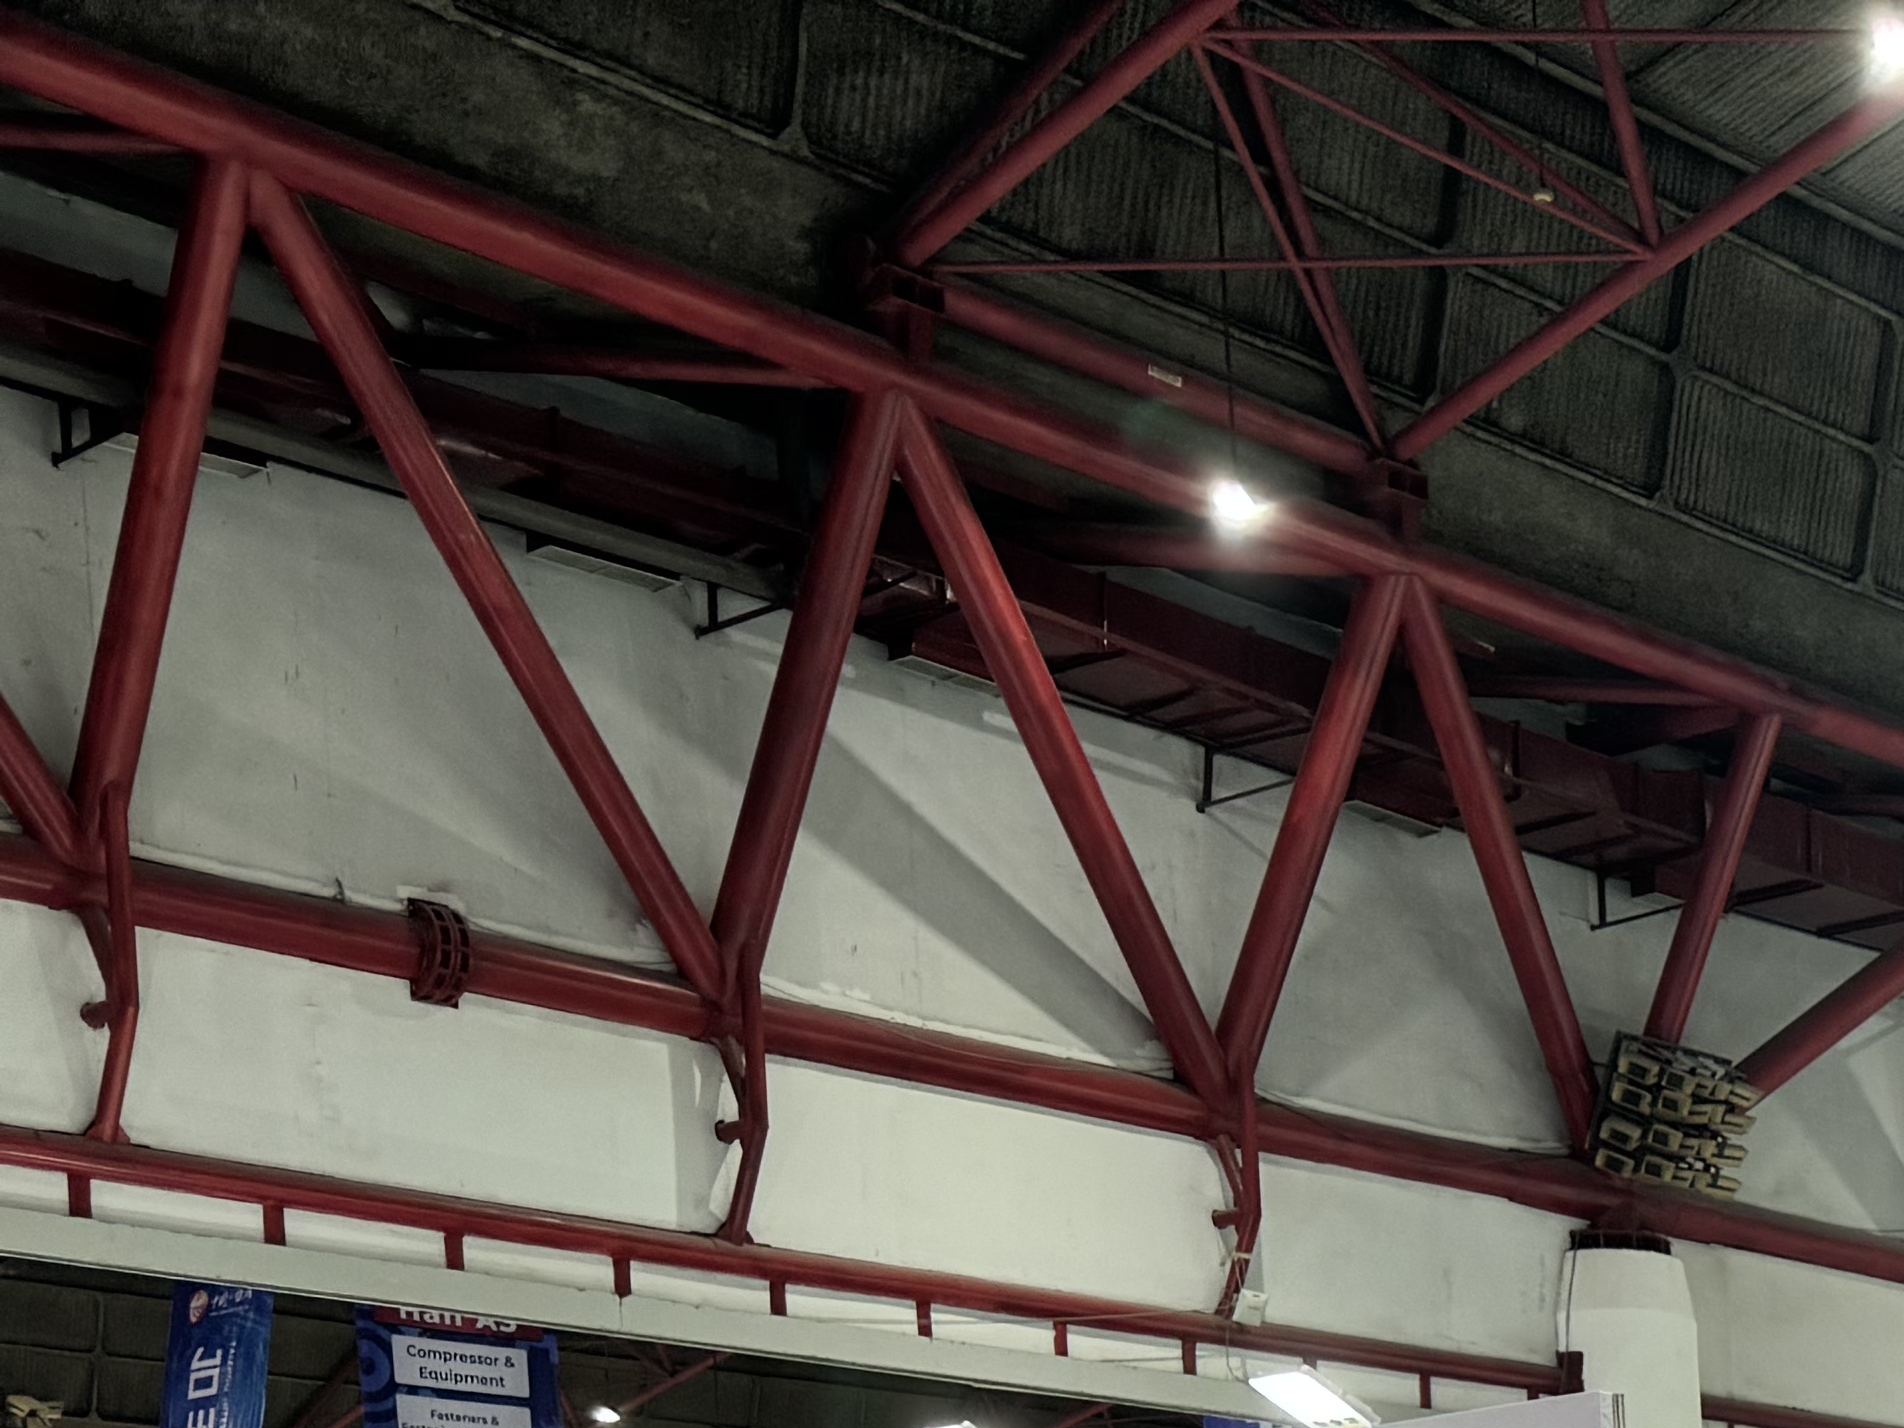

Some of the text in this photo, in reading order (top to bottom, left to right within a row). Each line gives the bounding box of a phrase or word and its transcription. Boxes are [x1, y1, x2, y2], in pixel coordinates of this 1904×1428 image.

[406, 1345, 516, 1369] Compressor &
[419, 1366, 506, 1388] Equipment
[430, 1409, 488, 1426] Fasteners
